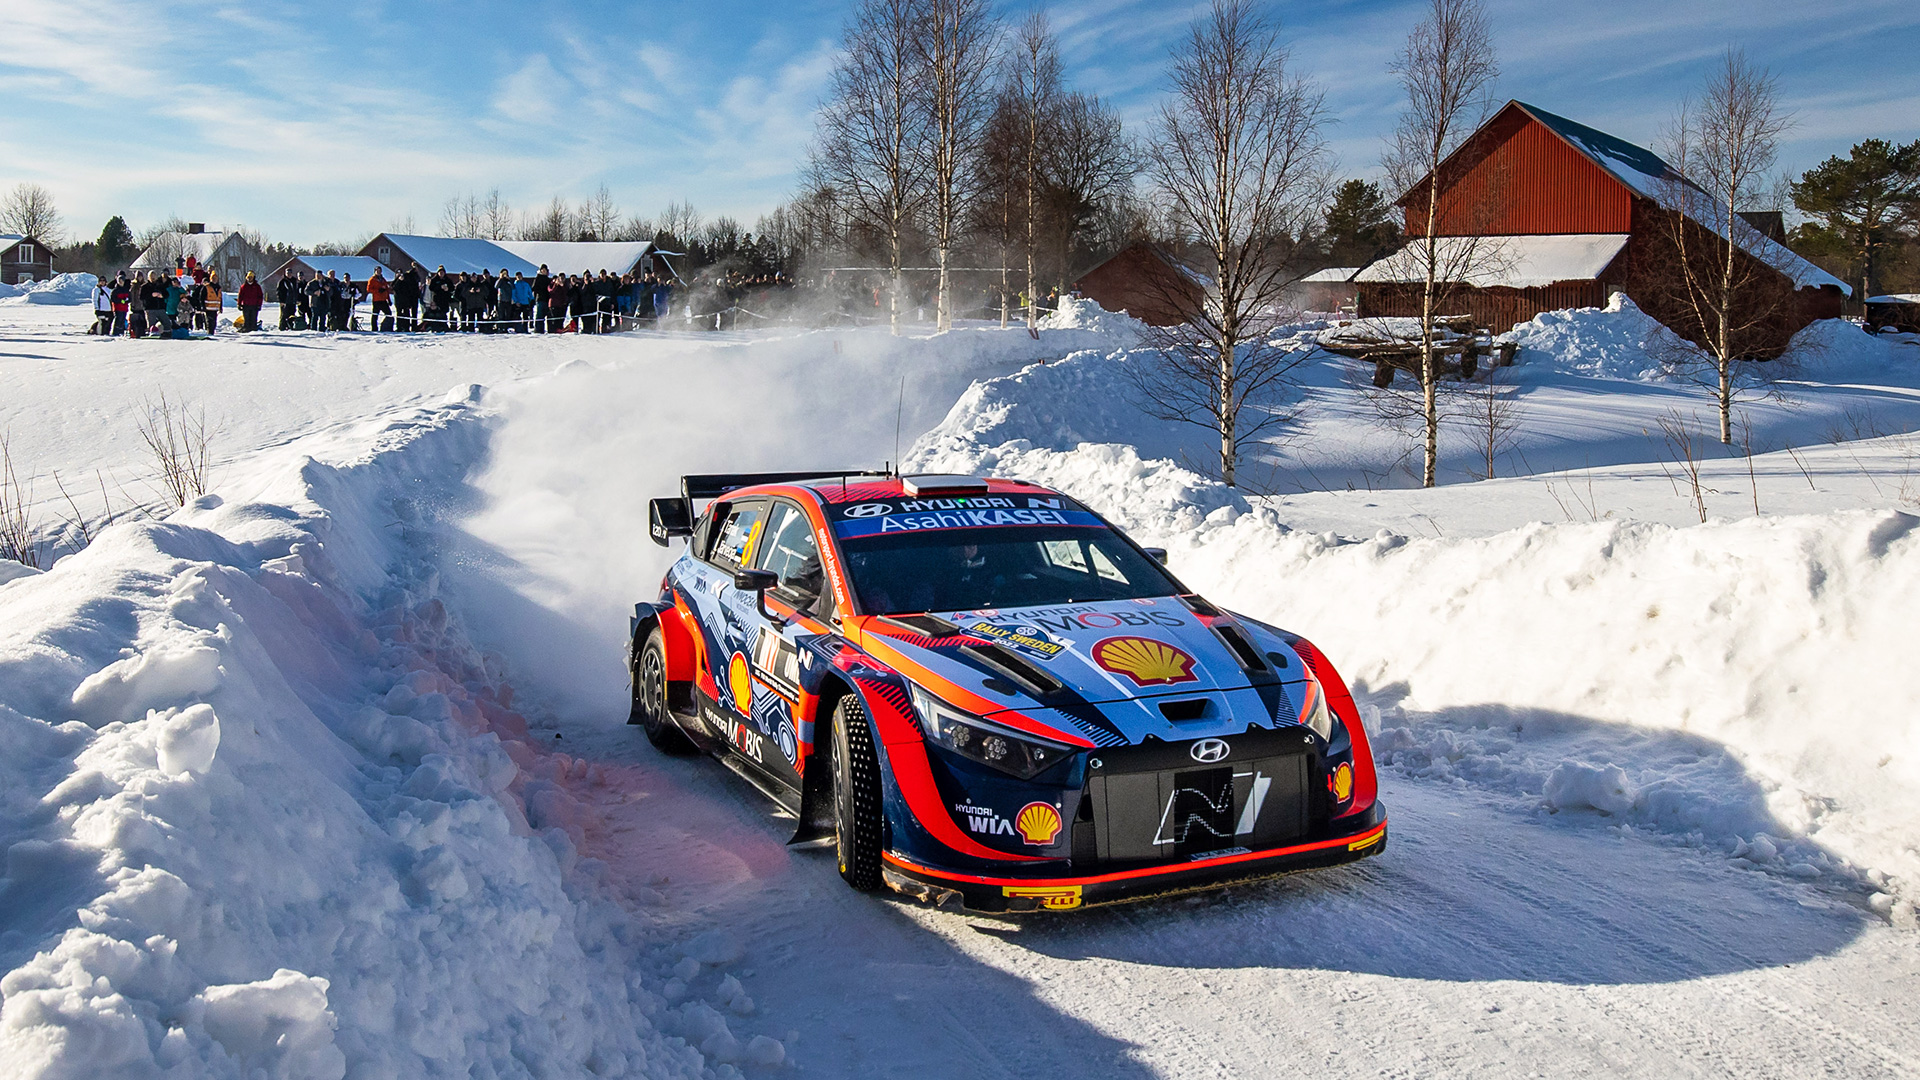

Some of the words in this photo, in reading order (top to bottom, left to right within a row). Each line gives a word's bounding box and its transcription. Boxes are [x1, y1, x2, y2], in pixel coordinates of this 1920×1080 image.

[901, 497, 1015, 511] HYUNDAI
[881, 510, 1069, 532] AsahiKASEI
[740, 520, 762, 567] 8
[987, 605, 1099, 623] HYUNDAI
[1032, 610, 1186, 634] MOBIS
[972, 622, 1012, 637] RALLY
[1008, 633, 1062, 654] SWEDEN
[727, 716, 763, 764] MOBIS
[955, 803, 993, 817] HYUNDAI
[968, 815, 1016, 836] WIA
